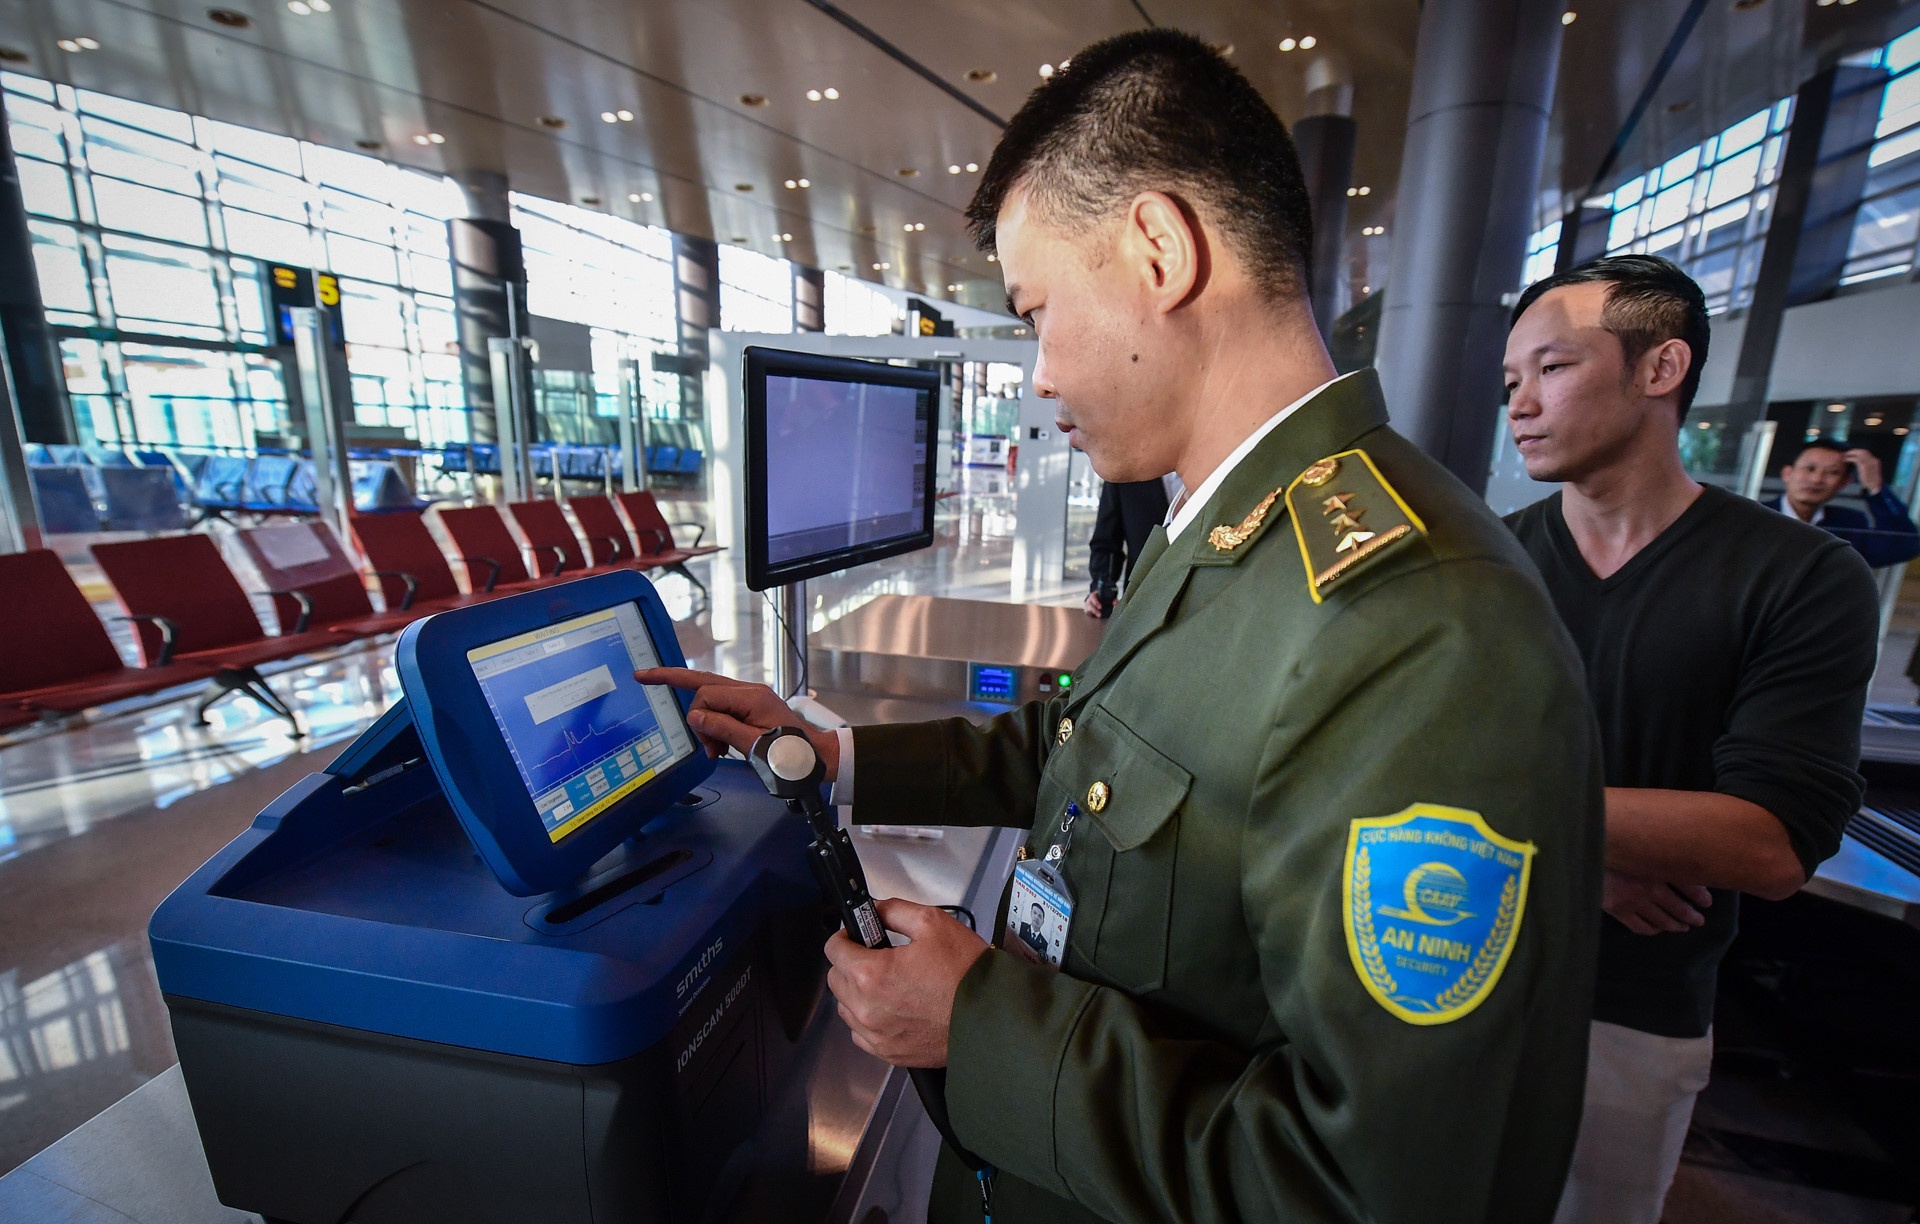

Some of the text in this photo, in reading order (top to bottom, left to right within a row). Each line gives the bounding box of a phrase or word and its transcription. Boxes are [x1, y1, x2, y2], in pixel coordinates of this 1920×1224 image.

[318, 275, 339, 305] 5
[533, 627, 560, 640] WAITING
[1361, 829, 1386, 844] CỤC
[1388, 827, 1422, 843] HÀNG
[1425, 830, 1468, 850] KHÔNG
[1013, 905, 1018, 913] 2
[1011, 921, 1015, 929] 3
[1057, 924, 1063, 932] 4
[1055, 939, 1060, 947] 5
[1381, 926, 1472, 963] AN NINH
[676, 936, 723, 999] smiths
[1052, 955, 1057, 963] 6
[1396, 955, 1448, 976] SECURITY
[677, 965, 752, 1073] IONSCAN 500DT
